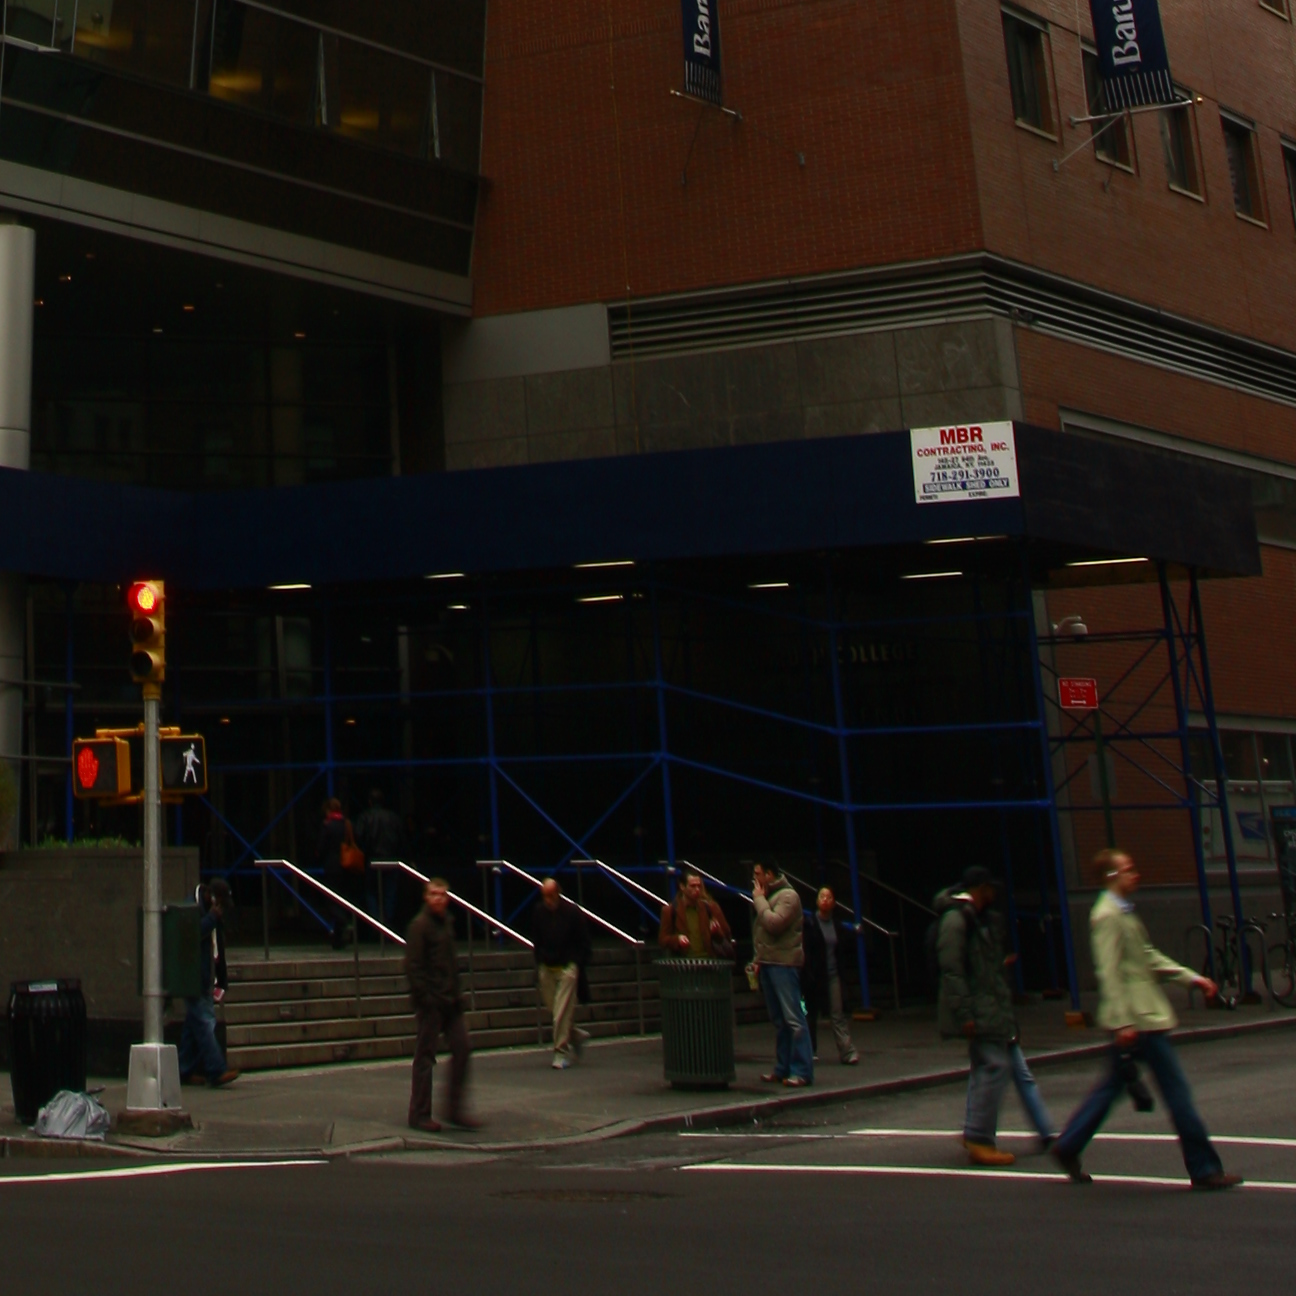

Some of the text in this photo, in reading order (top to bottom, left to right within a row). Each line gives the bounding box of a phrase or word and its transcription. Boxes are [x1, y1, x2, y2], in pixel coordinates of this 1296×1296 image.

[940, 427, 983, 445] MBR
[917, 442, 1010, 457] CONTRACTING, INC.
[930, 468, 1000, 482] 718-291-3900
[924, 477, 1008, 493] SIDEWALK SHED ONLY
